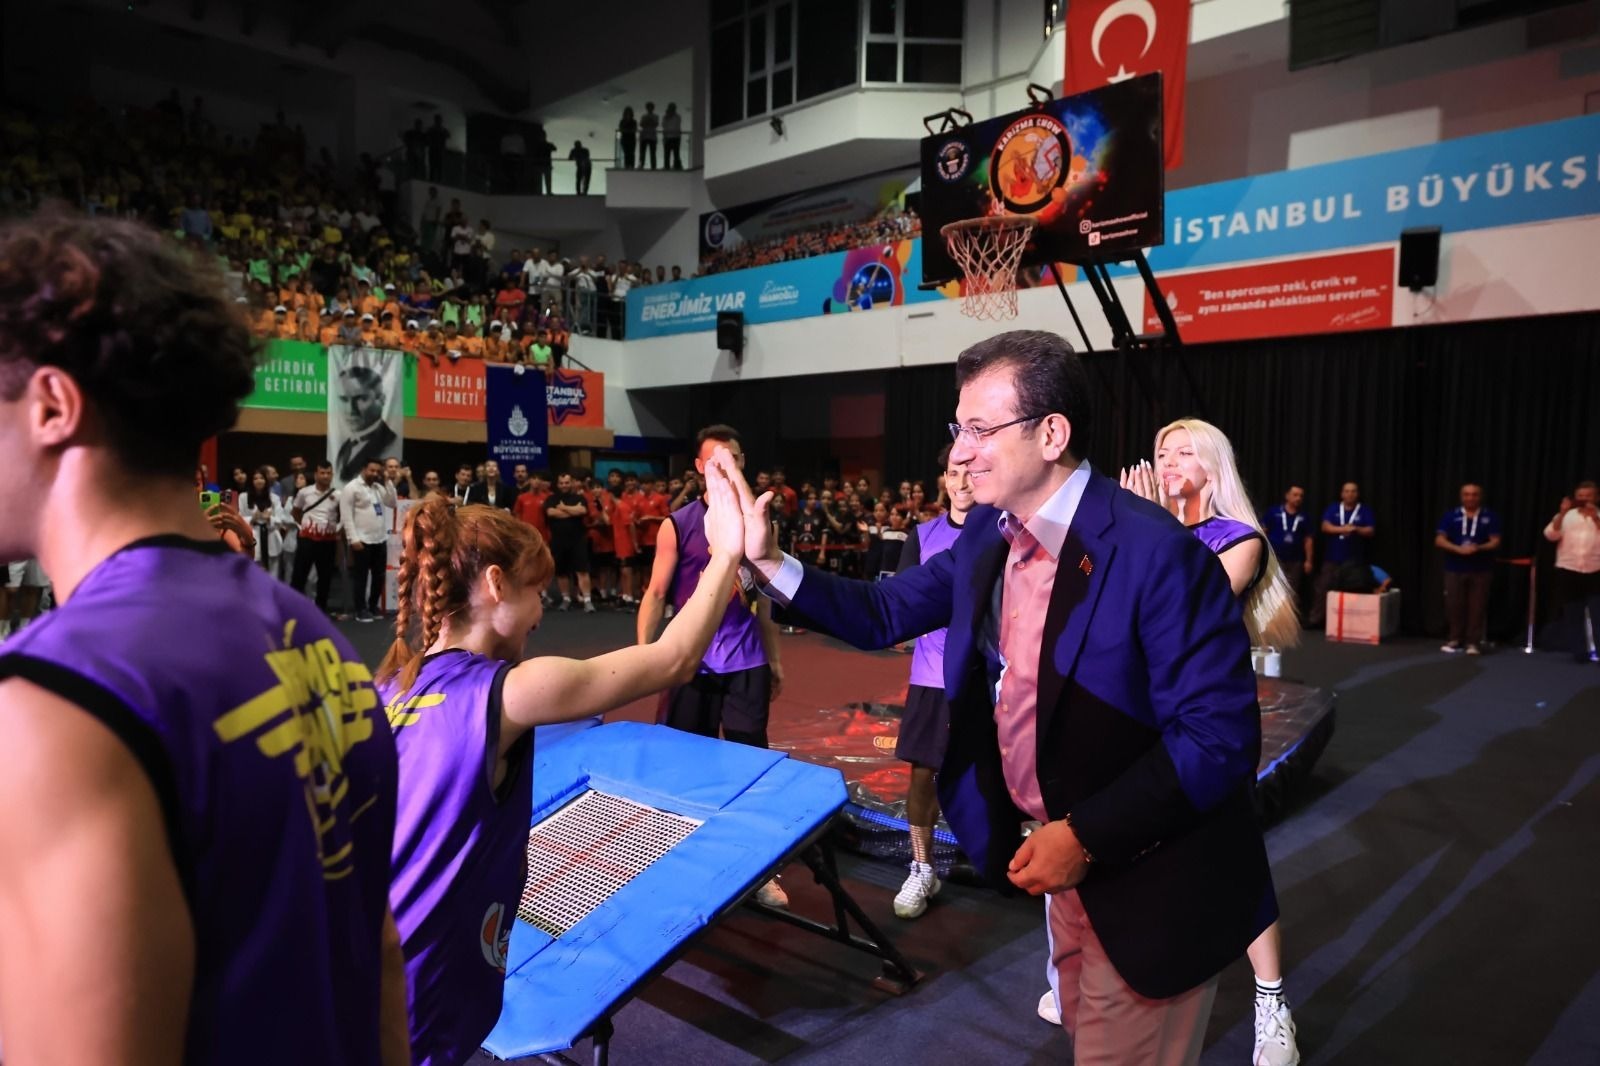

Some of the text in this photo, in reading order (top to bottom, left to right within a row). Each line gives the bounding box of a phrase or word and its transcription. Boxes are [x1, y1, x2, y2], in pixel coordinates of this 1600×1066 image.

[1173, 153, 1600, 245] İSTANBUL BÜYÜKŞ
[1226, 284, 1280, 299] sporcunun
[1282, 280, 1308, 293] zeki,
[1310, 276, 1341, 291] çevik
[1343, 276, 1357, 286] ve
[641, 292, 713, 322] ENERJİMİZ
[715, 291, 746, 313] VAR
[1221, 299, 1267, 313] zamanda
[264, 376, 327, 395] GETİRDİK
[434, 389, 478, 406] HİZMETİ
